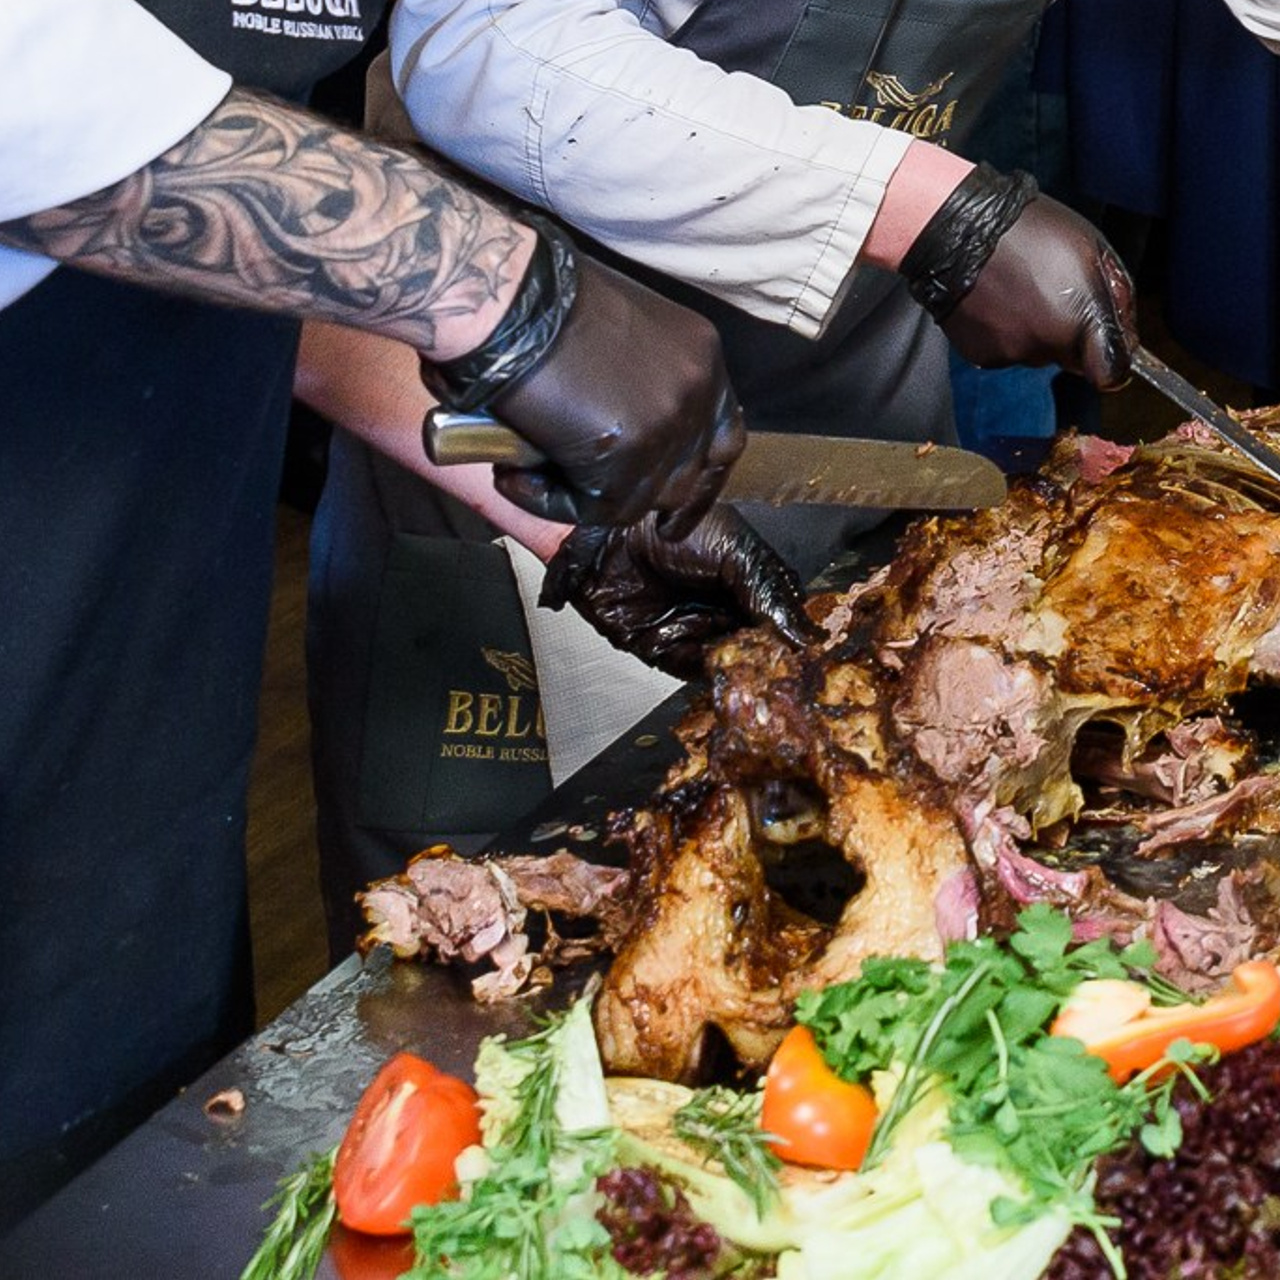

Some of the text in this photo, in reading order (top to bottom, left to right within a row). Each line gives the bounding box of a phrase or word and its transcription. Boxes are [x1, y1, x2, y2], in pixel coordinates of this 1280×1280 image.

[232, 10, 282, 34] NOBLE
[443, 689, 547, 739] BEL
[441, 743, 549, 761] NOBLE RUSSI
